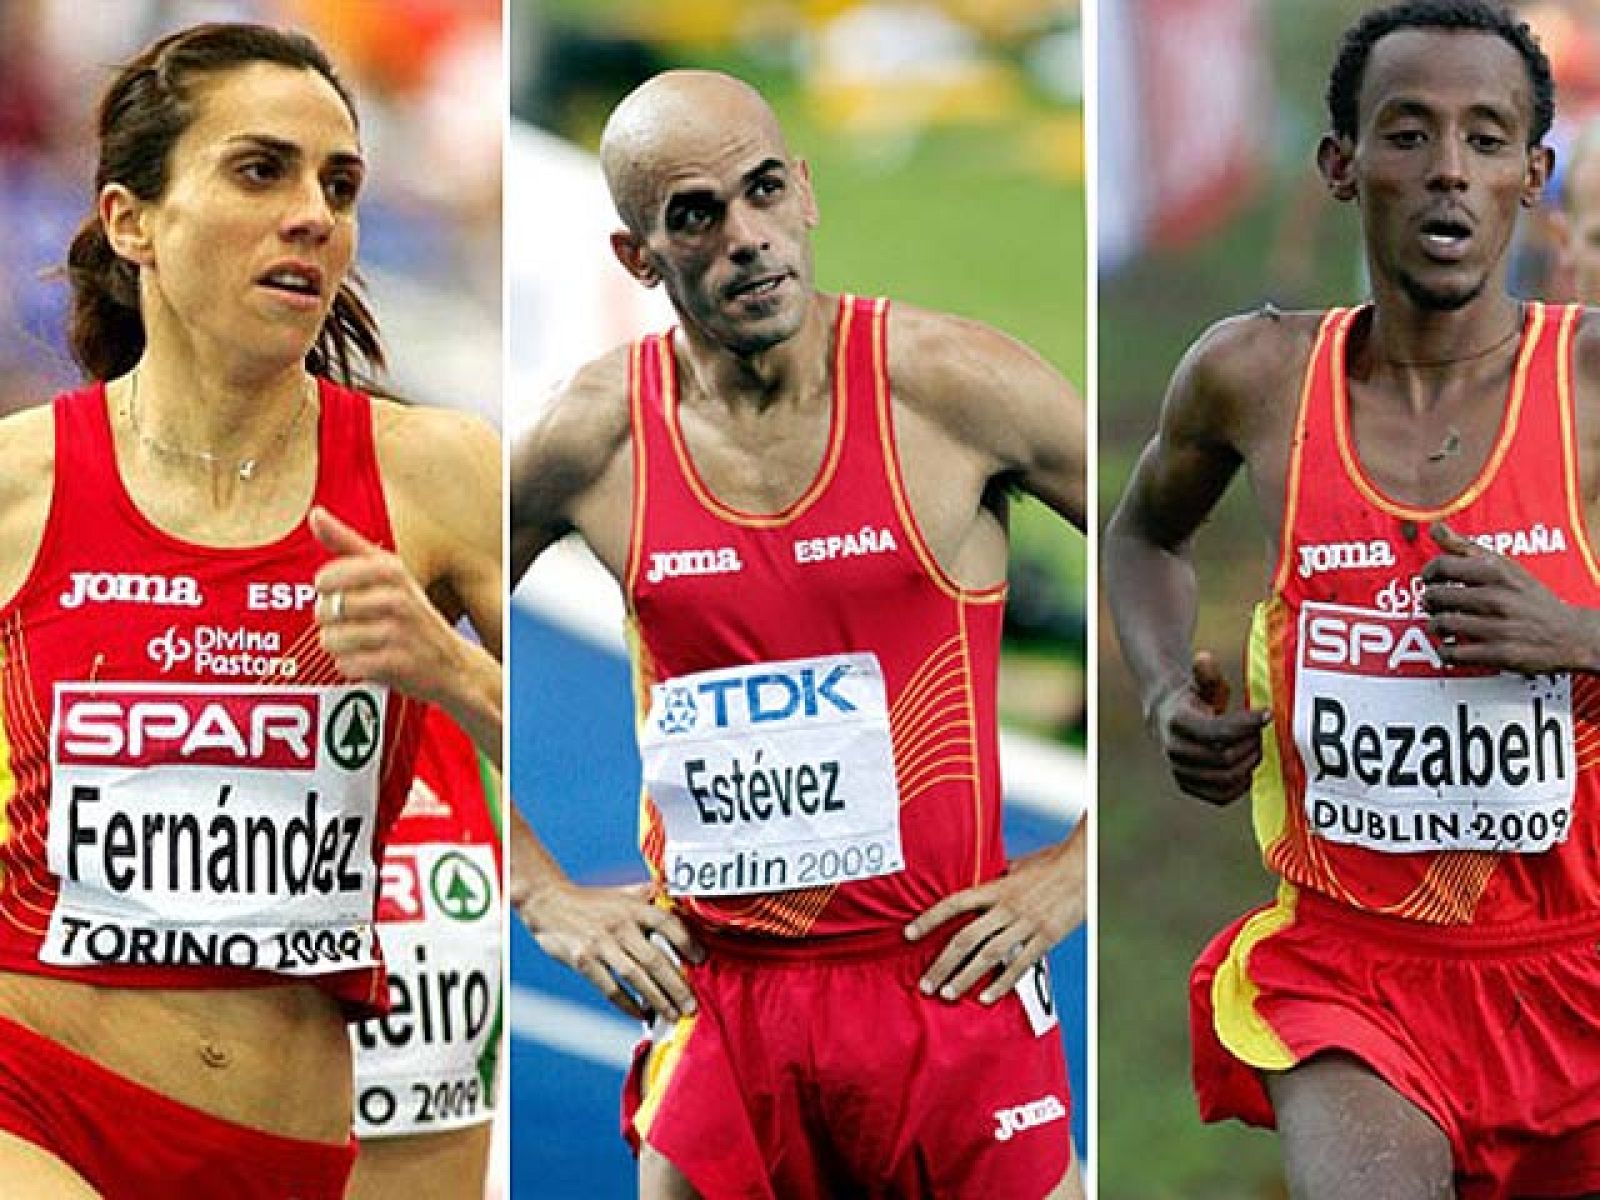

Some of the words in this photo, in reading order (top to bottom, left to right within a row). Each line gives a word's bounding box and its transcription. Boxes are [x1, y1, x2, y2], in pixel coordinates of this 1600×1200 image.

[794, 525, 898, 563] ESPAÑA
[247, 583, 318, 611] ESP
[195, 652, 297, 676] Pastora
[1309, 619, 1443, 669] SPA
[699, 664, 857, 728] TDK
[64, 702, 312, 758] SPAR
[1312, 696, 1566, 788] Bezabeh
[684, 749, 846, 824] Estévez
[68, 785, 363, 895] Fernández
[1313, 800, 1460, 843] DUBLIN
[1473, 809, 1569, 842] 2009
[672, 852, 788, 892] berlin
[797, 842, 885, 882] 2009
[60, 917, 258, 967] TORINO
[412, 1080, 479, 1123] 2009
